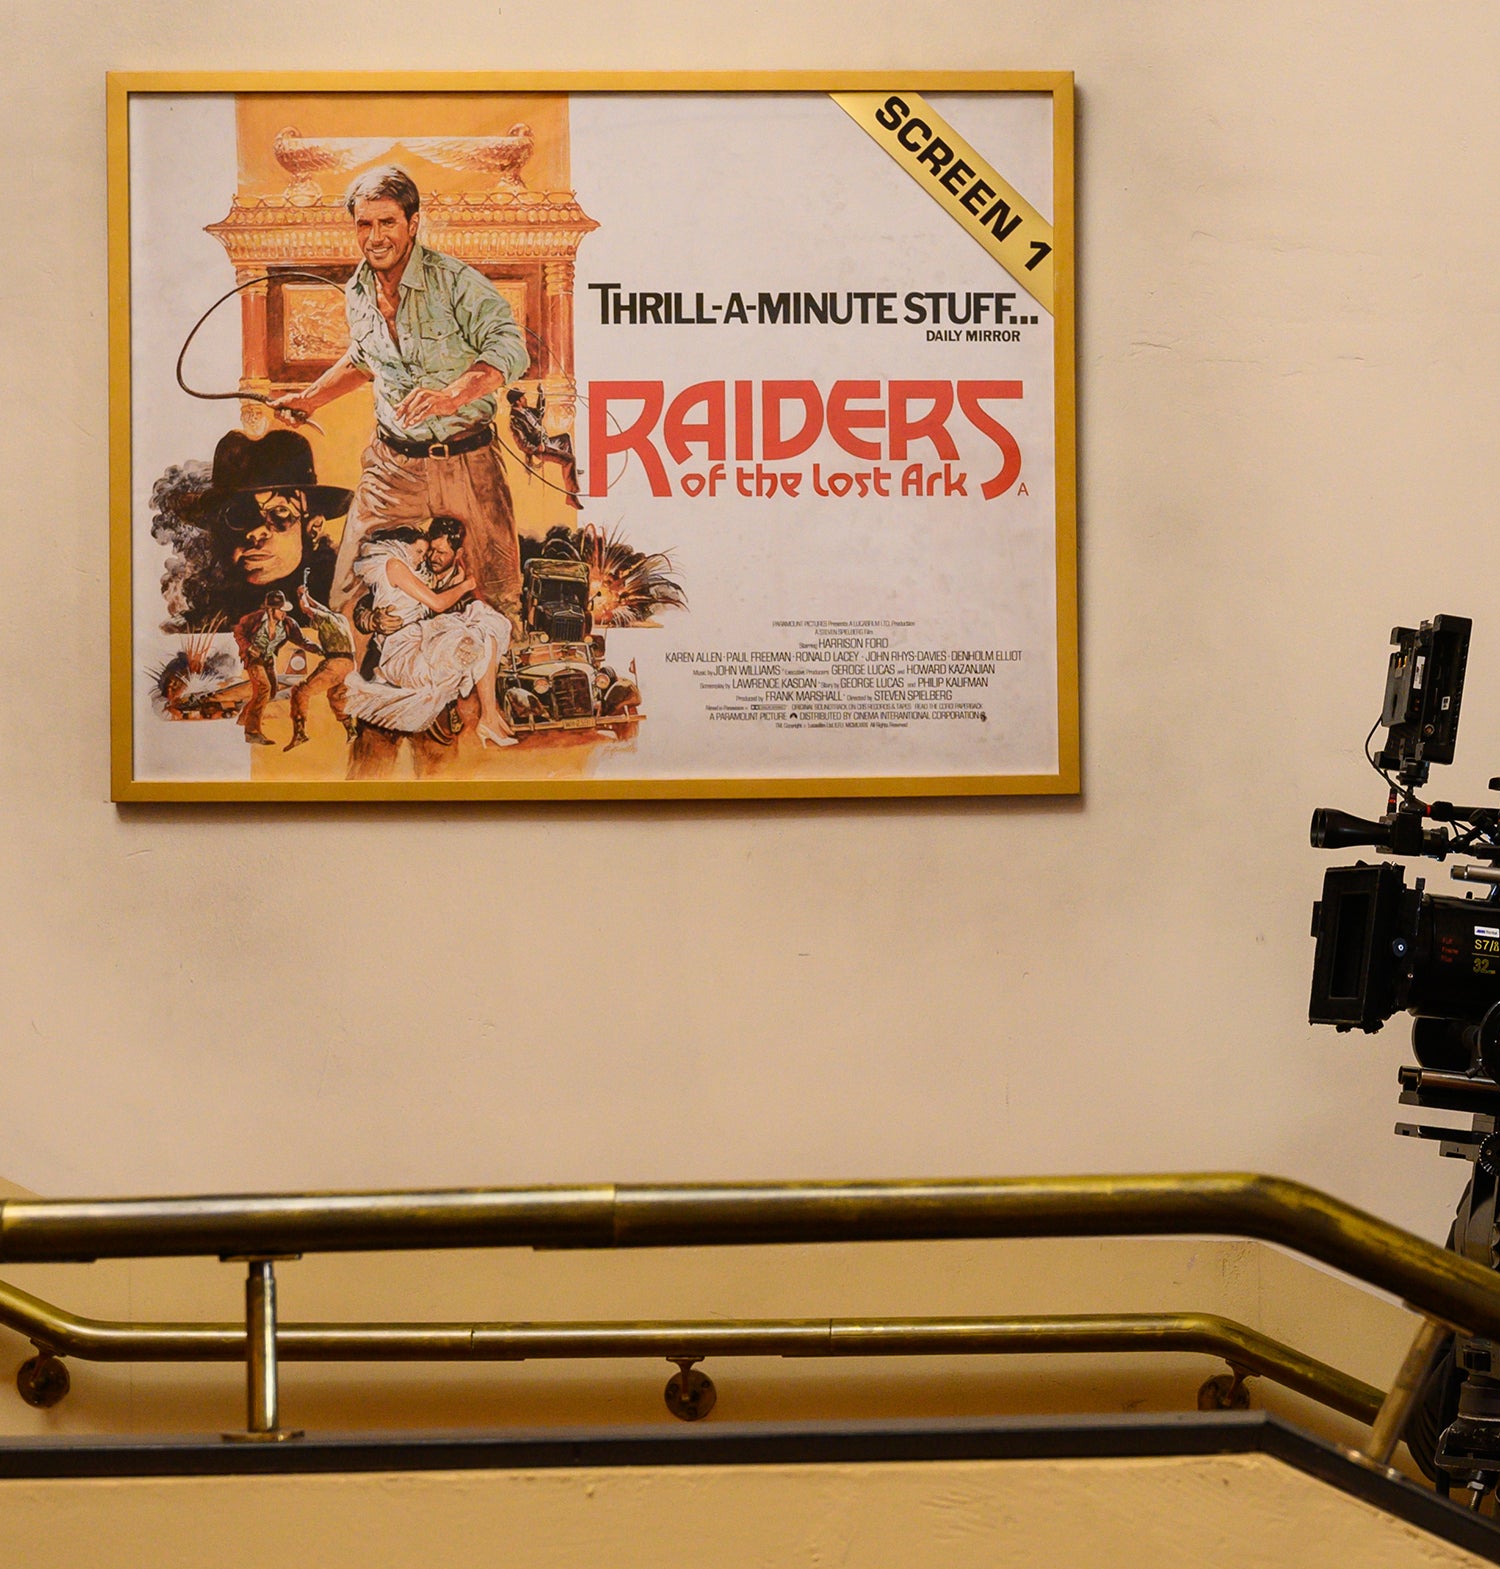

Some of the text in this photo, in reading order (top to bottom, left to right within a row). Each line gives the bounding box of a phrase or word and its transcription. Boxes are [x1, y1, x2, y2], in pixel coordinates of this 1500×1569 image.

[875, 96, 1053, 271] SCREEN 1
[588, 283, 1038, 325] THRILL-A-MINUTE STUFF...
[926, 330, 1021, 342] DAILY MIRROR
[588, 380, 1024, 502] RAIDERS
[680, 463, 726, 497] of
[736, 463, 802, 497] the
[902, 463, 968, 496] Ark
[1017, 485, 1030, 498] A
[818, 638, 863, 649] HARRISON
[865, 638, 889, 649] FORD
[665, 651, 694, 662] KAREN
[696, 651, 722, 662] ALLEN
[726, 651, 748, 662] PAUL
[751, 651, 791, 662] FREEMAN
[796, 651, 831, 662] RONALD
[833, 651, 859, 662] LACEY
[866, 651, 889, 662] JOHN
[951, 651, 993, 662] DENHOLM
[996, 651, 1022, 662] ELLIOT
[714, 665, 737, 675] JOHN
[739, 665, 781, 675] WILLIAMS
[868, 664, 895, 675] LUCAS
[907, 664, 946, 675] HOWARD
[949, 664, 995, 675] KAZANJIAN
[732, 678, 780, 688] LAWRENCE
[781, 678, 817, 688] KASDAN
[840, 678, 874, 688] GEORGE
[876, 678, 904, 688] LUCAS
[918, 677, 944, 687] PHILIP
[946, 677, 988, 687] KAUFMAN
[765, 690, 794, 701] FRANK
[795, 690, 842, 701] MARSHALL
[874, 690, 906, 701] STEVEN
[907, 690, 953, 701] SPIELBERG
[716, 712, 758, 720] PARAMOUNT
[759, 712, 786, 720] PICTURE
[799, 712, 841, 720] DISTRIBUTED
[843, 712, 852, 720] BY
[853, 712, 879, 720] CINEMA
[932, 711, 979, 719] CORPORATION
